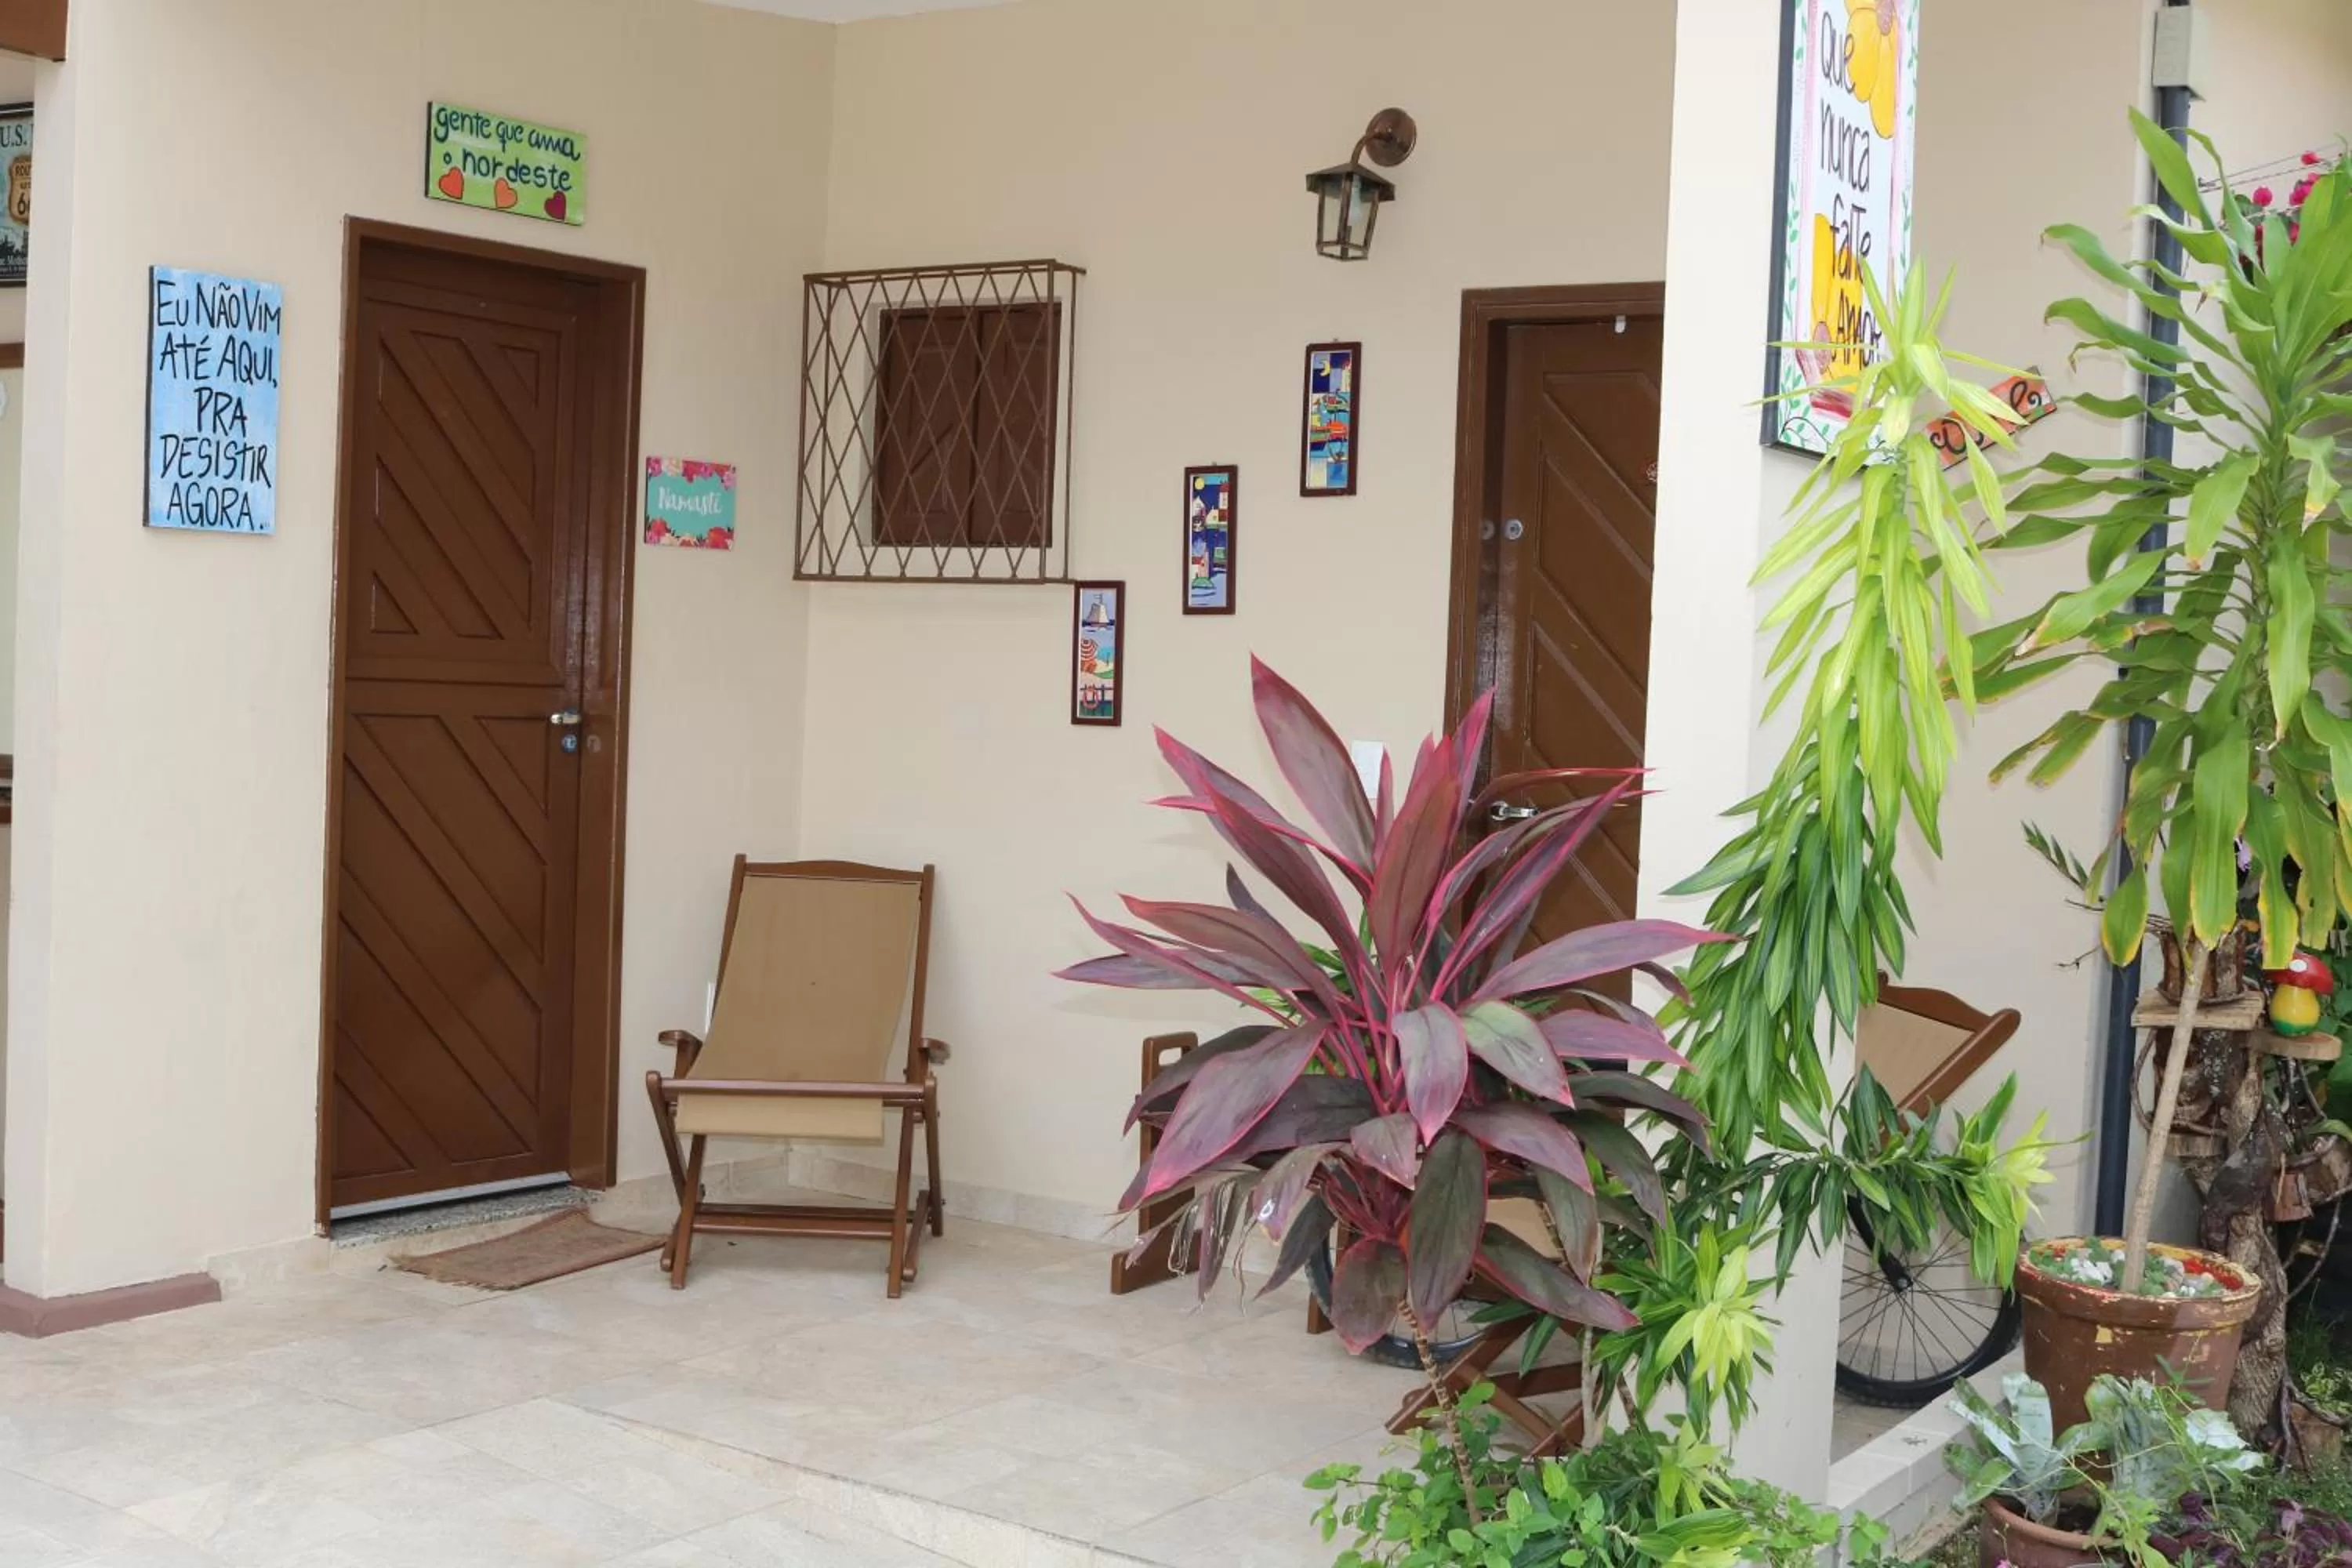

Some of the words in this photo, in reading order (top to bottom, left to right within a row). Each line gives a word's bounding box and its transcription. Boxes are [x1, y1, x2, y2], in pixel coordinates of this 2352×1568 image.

[1820, 11, 1856, 94] Que
[434, 107, 492, 143] gente
[495, 121, 524, 153] que
[528, 129, 581, 162] ama
[1820, 96, 1870, 193] nunca
[443, 151, 452, 165] o
[462, 147, 573, 191] nordeste
[196, 281, 241, 329] NÃO
[242, 288, 281, 336] VIM
[159, 331, 212, 380] ATÉ
[216, 334, 278, 389] AQUI,
[194, 387, 248, 437] PRA
[160, 434, 272, 489] DESISTIR
